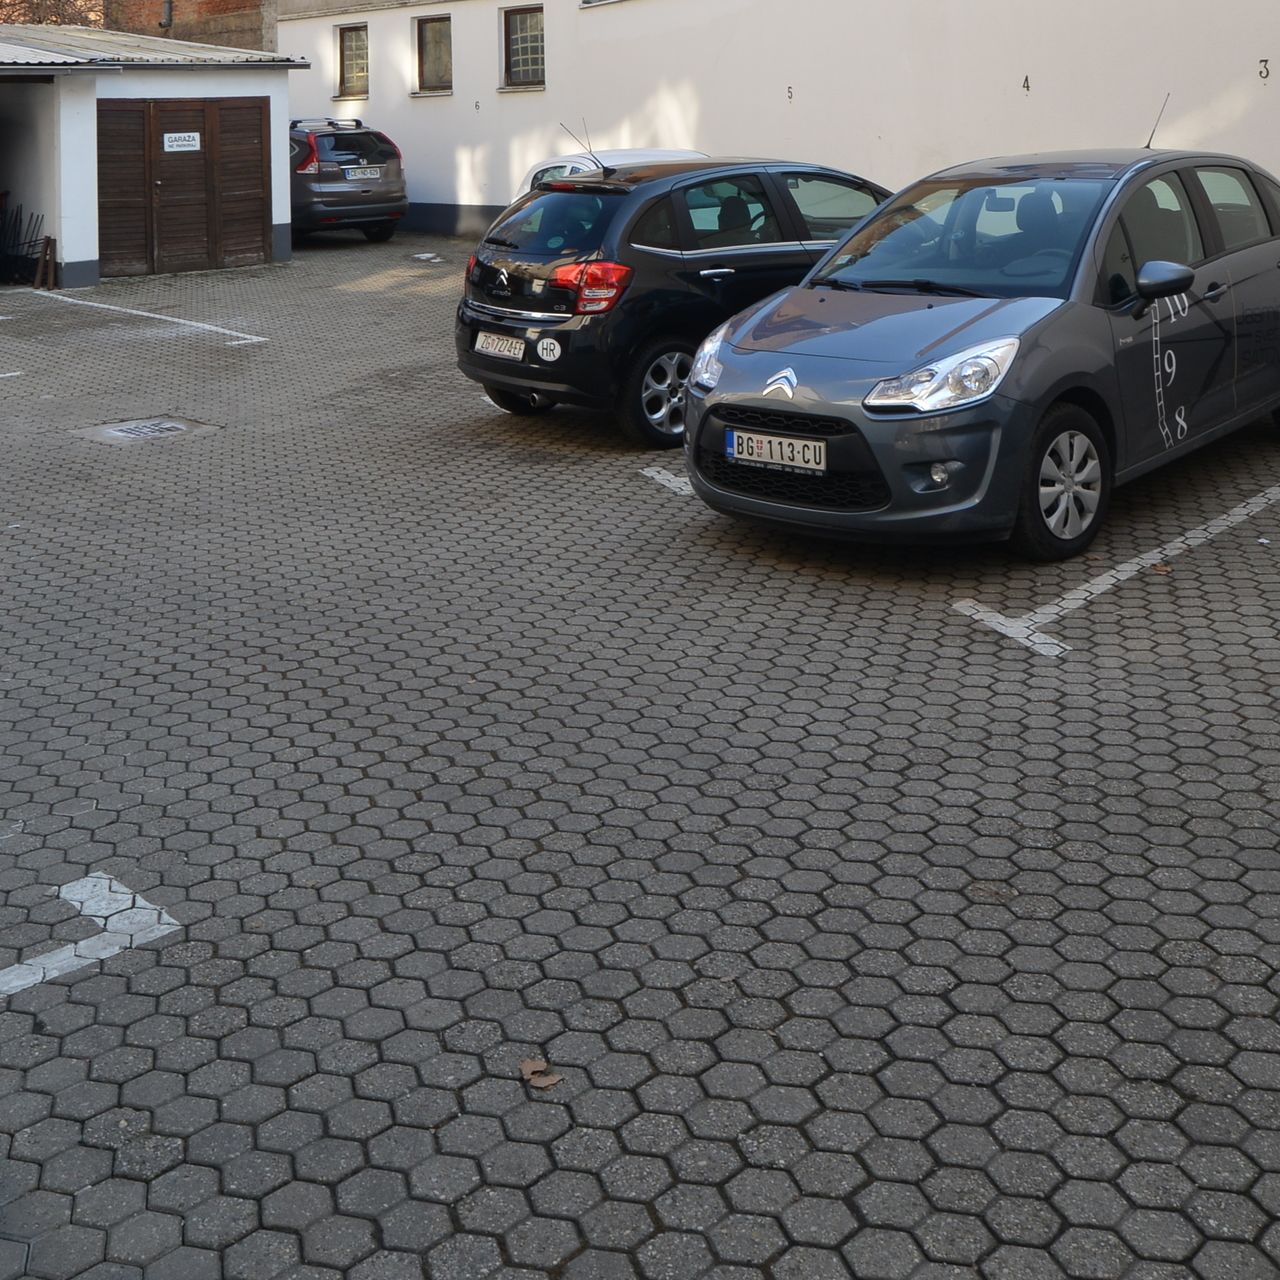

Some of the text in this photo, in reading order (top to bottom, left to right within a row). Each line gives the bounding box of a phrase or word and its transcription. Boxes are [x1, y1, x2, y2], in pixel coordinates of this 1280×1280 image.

[1259, 59, 1270, 79] 3
[1022, 74, 1031, 92] 4
[787, 86, 793, 100] 5
[474, 100, 480, 111] 6
[1164, 292, 1189, 323] 10
[480, 334, 490, 352] ZG
[541, 340, 557, 359] HR
[1164, 349, 1177, 387] 9
[1174, 405, 1188, 440] 8
[736, 435, 755, 457] BG
